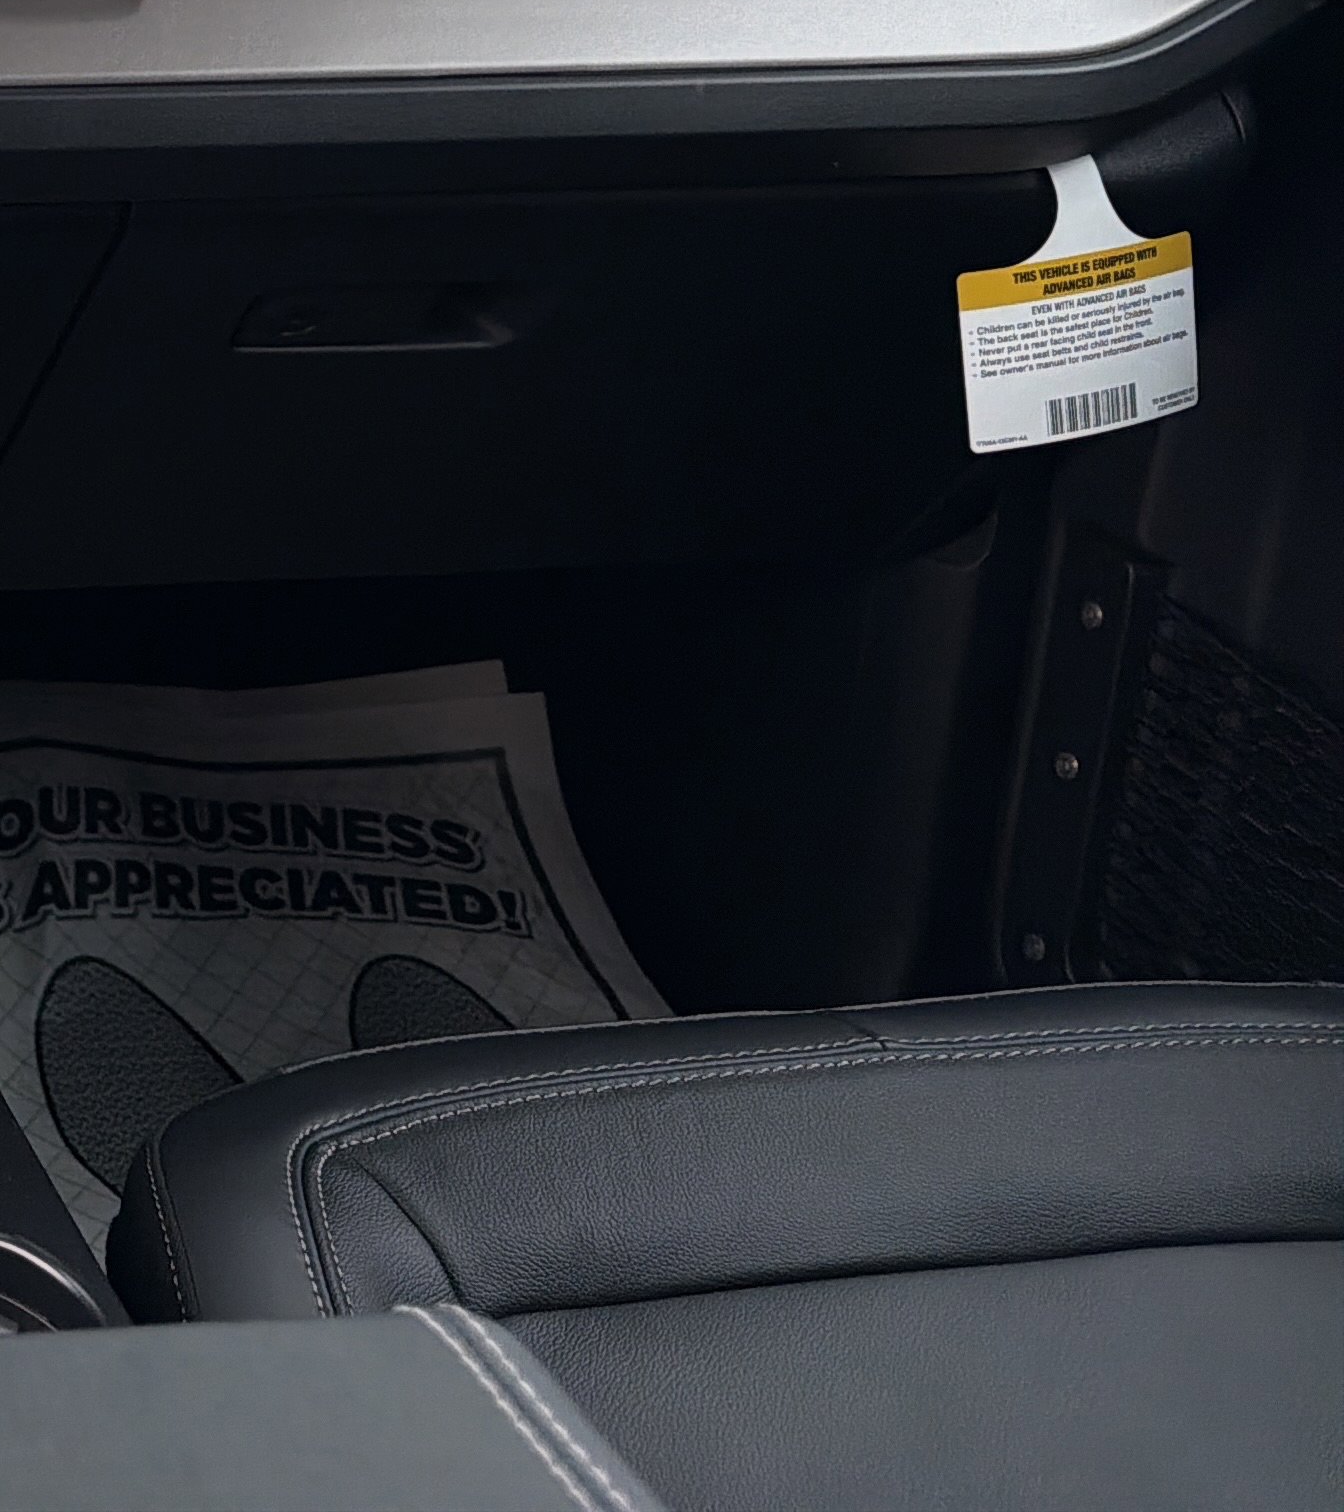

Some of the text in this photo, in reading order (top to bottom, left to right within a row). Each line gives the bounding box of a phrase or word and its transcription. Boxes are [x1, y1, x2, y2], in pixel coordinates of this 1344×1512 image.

[1013, 246, 1157, 284] THIS VEHICLE IS EQUIPPED WITH
[1043, 267, 1136, 296] ADVANCED AIR BAGS
[976, 323, 1015, 335] Children
[1017, 321, 1033, 330] can
[1035, 318, 1046, 327] be
[1047, 314, 1069, 325] killed
[1071, 312, 1080, 320] or
[1081, 305, 1116, 319] seriously
[1117, 299, 1141, 311] injured
[1142, 296, 1151, 306] by
[1031, 284, 1147, 315] EVEN WITH ADVANCED AIR BAGS
[977, 314, 1123, 346] The back seat is the safest place for
[979, 347, 1005, 358] Never
[1007, 343, 1022, 354] put
[1031, 340, 1048, 349] rear
[1050, 335, 1075, 347] facing
[1076, 330, 1096, 341] child
[1097, 327, 1113, 337] seat
[1114, 325, 1122, 333] in
[1123, 322, 1134, 331] the
[979, 338, 1109, 367] Always use seat belts and child
[980, 336, 1162, 378] See owner's manual for more information about
[139, 793, 483, 866] BUSINESS
[23, 860, 526, 932] APPRECIATED!
